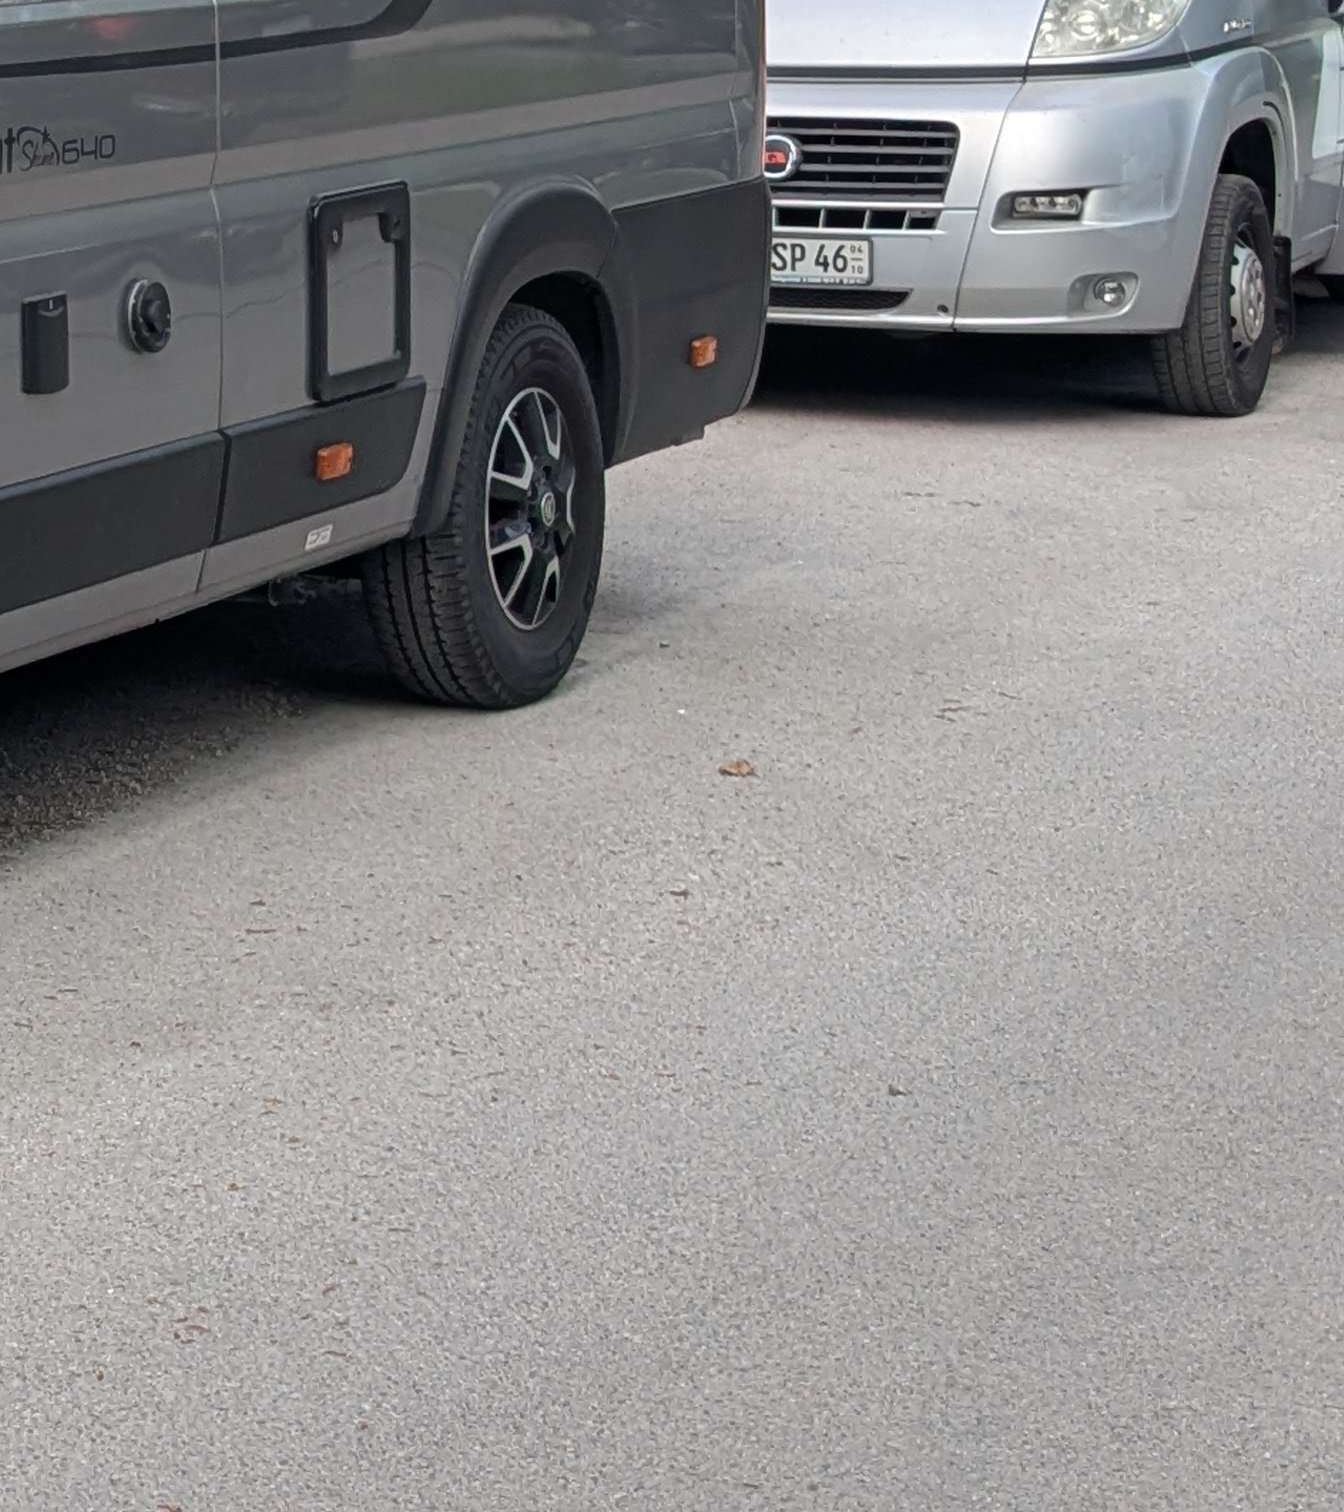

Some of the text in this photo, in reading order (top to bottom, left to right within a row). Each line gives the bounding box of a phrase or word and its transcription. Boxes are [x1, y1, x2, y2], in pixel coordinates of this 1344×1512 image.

[62, 134, 116, 164] 640
[771, 242, 848, 273] SP 46
